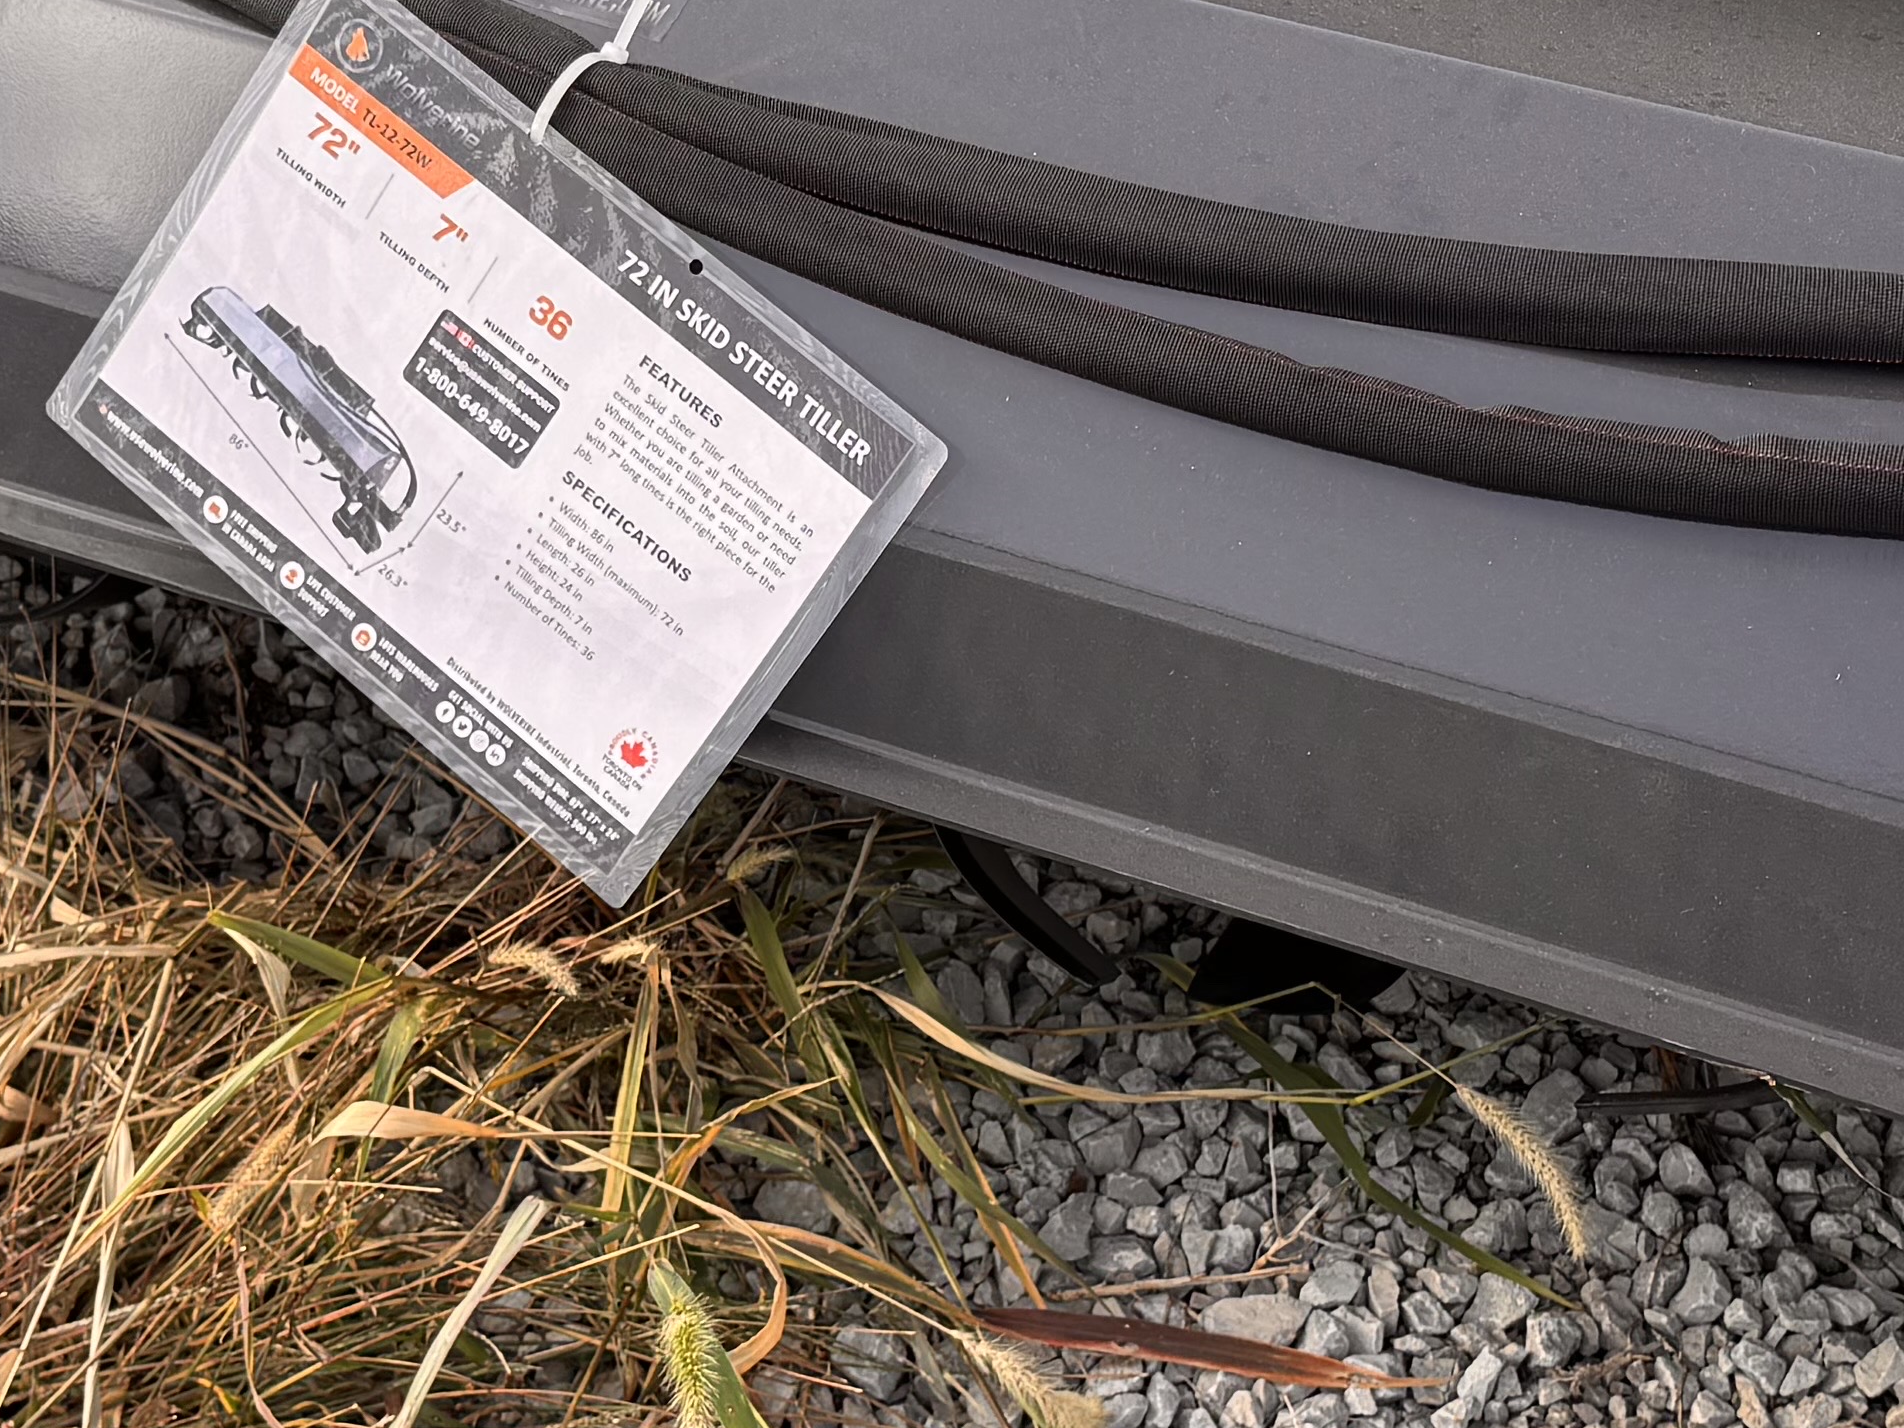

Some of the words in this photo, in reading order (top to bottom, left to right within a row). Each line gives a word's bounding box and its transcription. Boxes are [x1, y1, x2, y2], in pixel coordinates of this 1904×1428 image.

[305, 111, 361, 163] 72"
[309, 65, 360, 114] MODEL
[361, 107, 432, 169] TL-12-72W
[379, 62, 483, 149] Wolverine
[275, 146, 313, 182] TILLING
[313, 177, 346, 208] WIDTH
[378, 230, 417, 267] TILLING
[416, 262, 450, 293] DEPTH
[482, 317, 525, 355] NUMBER
[524, 351, 539, 365] OF
[540, 363, 570, 392] TINES
[527, 293, 574, 341] 36
[471, 343, 518, 385] CUSTOMER
[514, 378, 555, 414] SUPPORT
[615, 248, 650, 286] 72
[646, 273, 680, 309] IN
[674, 297, 732, 351] SKID
[727, 339, 800, 408] STEER
[796, 393, 872, 466] TILLER
[638, 354, 723, 428] FEATURES
[413, 355, 530, 455] 1-800-649-8017
[572, 443, 594, 466] job.
[603, 402, 645, 441] Whether
[644, 439, 665, 459] you
[665, 456, 683, 473] are
[683, 469, 713, 498] tilling
[711, 494, 720, 504] a
[719, 500, 756, 533] garden
[755, 530, 769, 543] or
[768, 540, 796, 566] need
[612, 389, 655, 428] excellent
[655, 425, 687, 455] choice
[687, 450, 705, 468] for
[704, 465, 720, 480] all
[718, 477, 743, 500] your
[742, 496, 772, 526] tilling
[771, 521, 803, 552] needs.
[622, 373, 641, 395] The
[643, 392, 667, 415] Skid
[668, 413, 696, 439] Steer
[699, 437, 725, 463] Tiller
[727, 462, 784, 512] Attachment
[799, 523, 814, 538] an
[558, 500, 591, 533] Width:
[589, 527, 605, 544] 86
[602, 538, 615, 553] in
[561, 469, 692, 583] SPECIFICATIONS
[584, 430, 607, 453] with
[618, 458, 642, 484] long
[641, 477, 666, 502] tines
[664, 496, 675, 510] is
[674, 505, 693, 524] the
[691, 520, 716, 544] right
[714, 540, 743, 566] piece
[742, 560, 759, 578] for
[757, 574, 776, 593] the
[593, 416, 606, 431] to
[608, 429, 628, 449] mix
[628, 446, 674, 486] materials
[674, 483, 696, 505] into
[697, 502, 716, 522] the
[740, 540, 760, 558] our
[761, 555, 786, 579] tiller
[524, 548, 560, 583] Height:
[558, 577, 573, 593] 24
[571, 587, 583, 602] in
[535, 532, 572, 568] Length:
[570, 561, 585, 578] 26
[583, 572, 595, 587] in
[547, 516, 576, 548] Tilling
[575, 540, 605, 570] Width
[602, 564, 660, 617] (maximum):
[659, 611, 674, 628] 72
[672, 622, 684, 636] in
[503, 580, 542, 616] Number
[540, 613, 555, 626] of
[552, 621, 581, 650] Tines:
[579, 645, 595, 661] 36
[514, 563, 543, 595] Tilling
[541, 588, 575, 620] Depth:
[573, 614, 583, 625] 7
[580, 621, 593, 635] in
